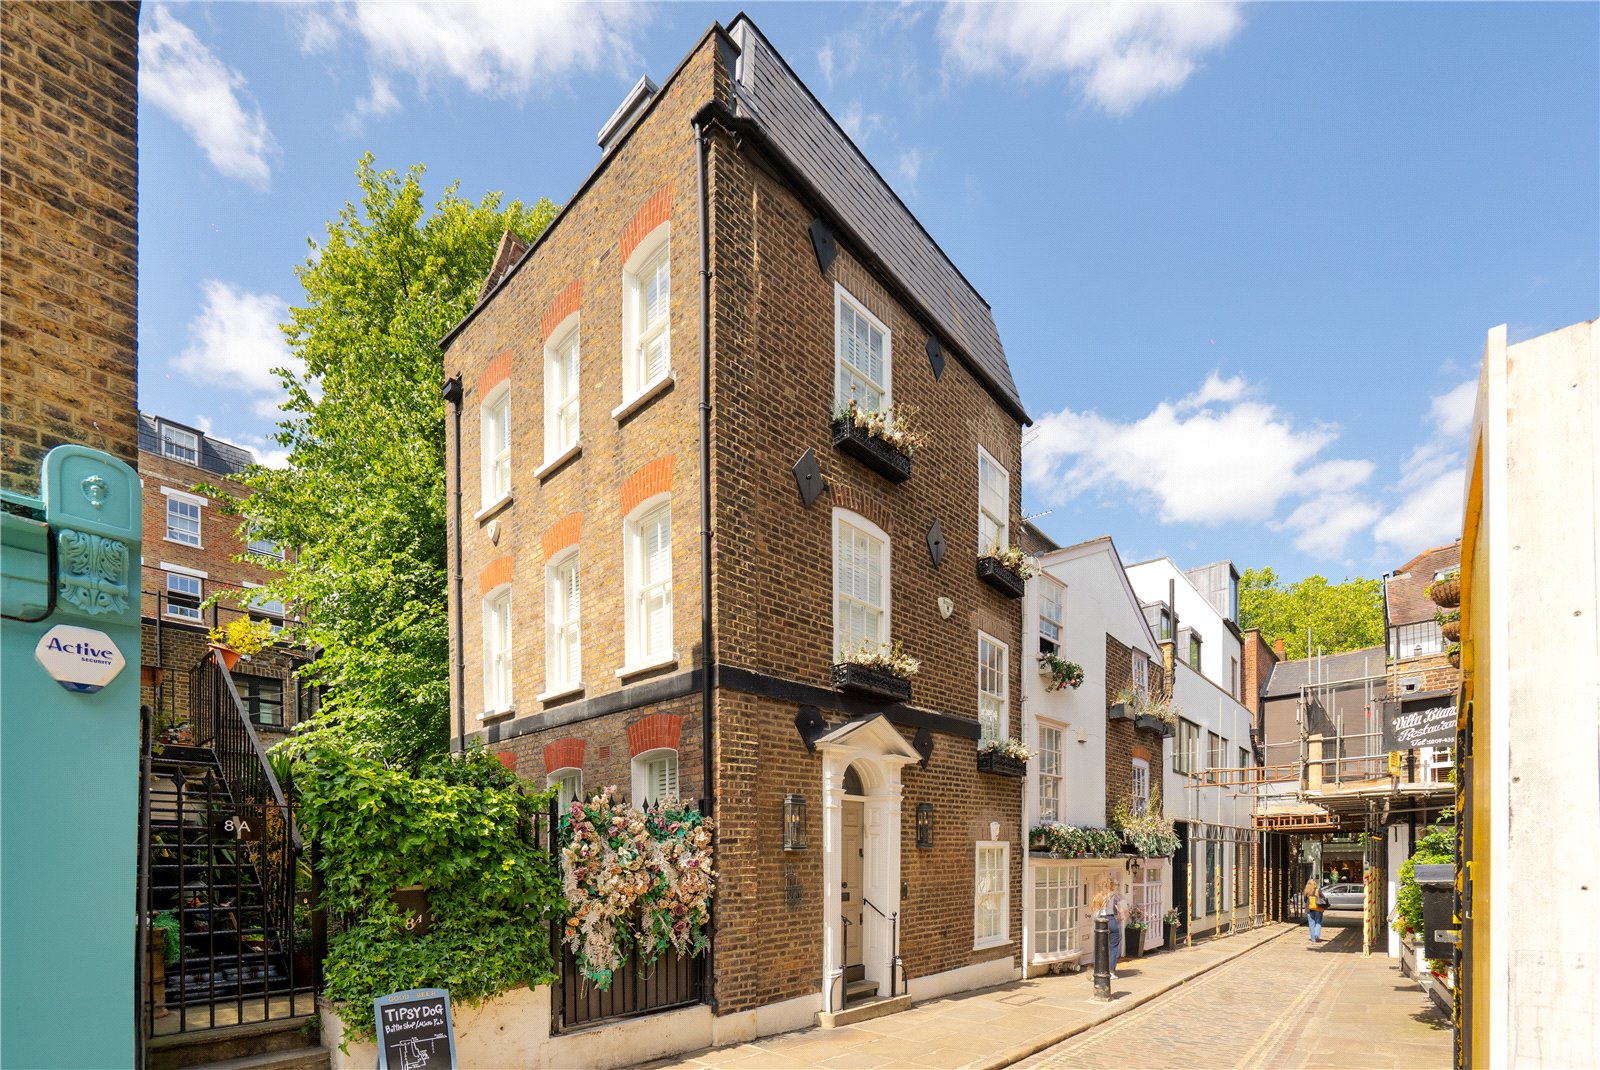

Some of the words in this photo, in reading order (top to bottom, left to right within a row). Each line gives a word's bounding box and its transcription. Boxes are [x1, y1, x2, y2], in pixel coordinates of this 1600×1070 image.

[46, 637, 113, 660] Active
[81, 657, 112, 665] SECURITY
[1392, 712, 1423, 731] Villa
